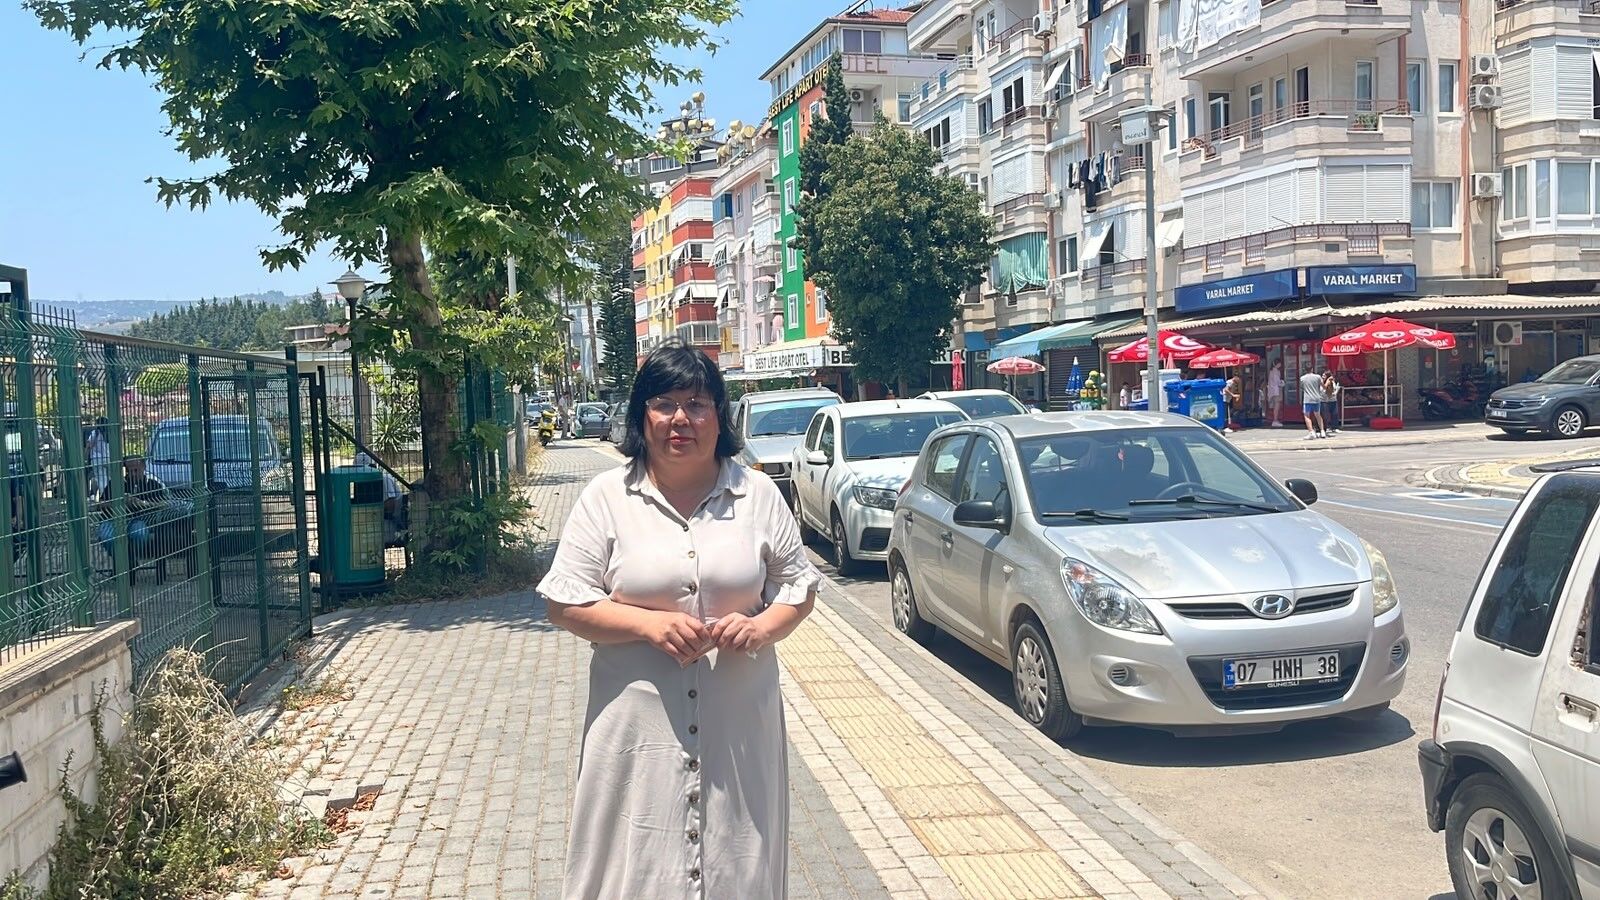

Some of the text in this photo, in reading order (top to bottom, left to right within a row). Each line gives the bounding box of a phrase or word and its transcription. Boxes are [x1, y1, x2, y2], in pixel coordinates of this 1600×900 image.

[781, 91, 794, 109] LIFE
[794, 74, 814, 101] APART
[1323, 273, 1403, 285] VARAL MARKET
[1205, 283, 1254, 299] VARAL MARKET
[755, 353, 810, 370] BEST LIFE APART OTEL
[831, 350, 851, 364] BE
[1237, 662, 1257, 681] 07
[1273, 658, 1303, 679] HNH
[1318, 655, 1337, 675] 38
